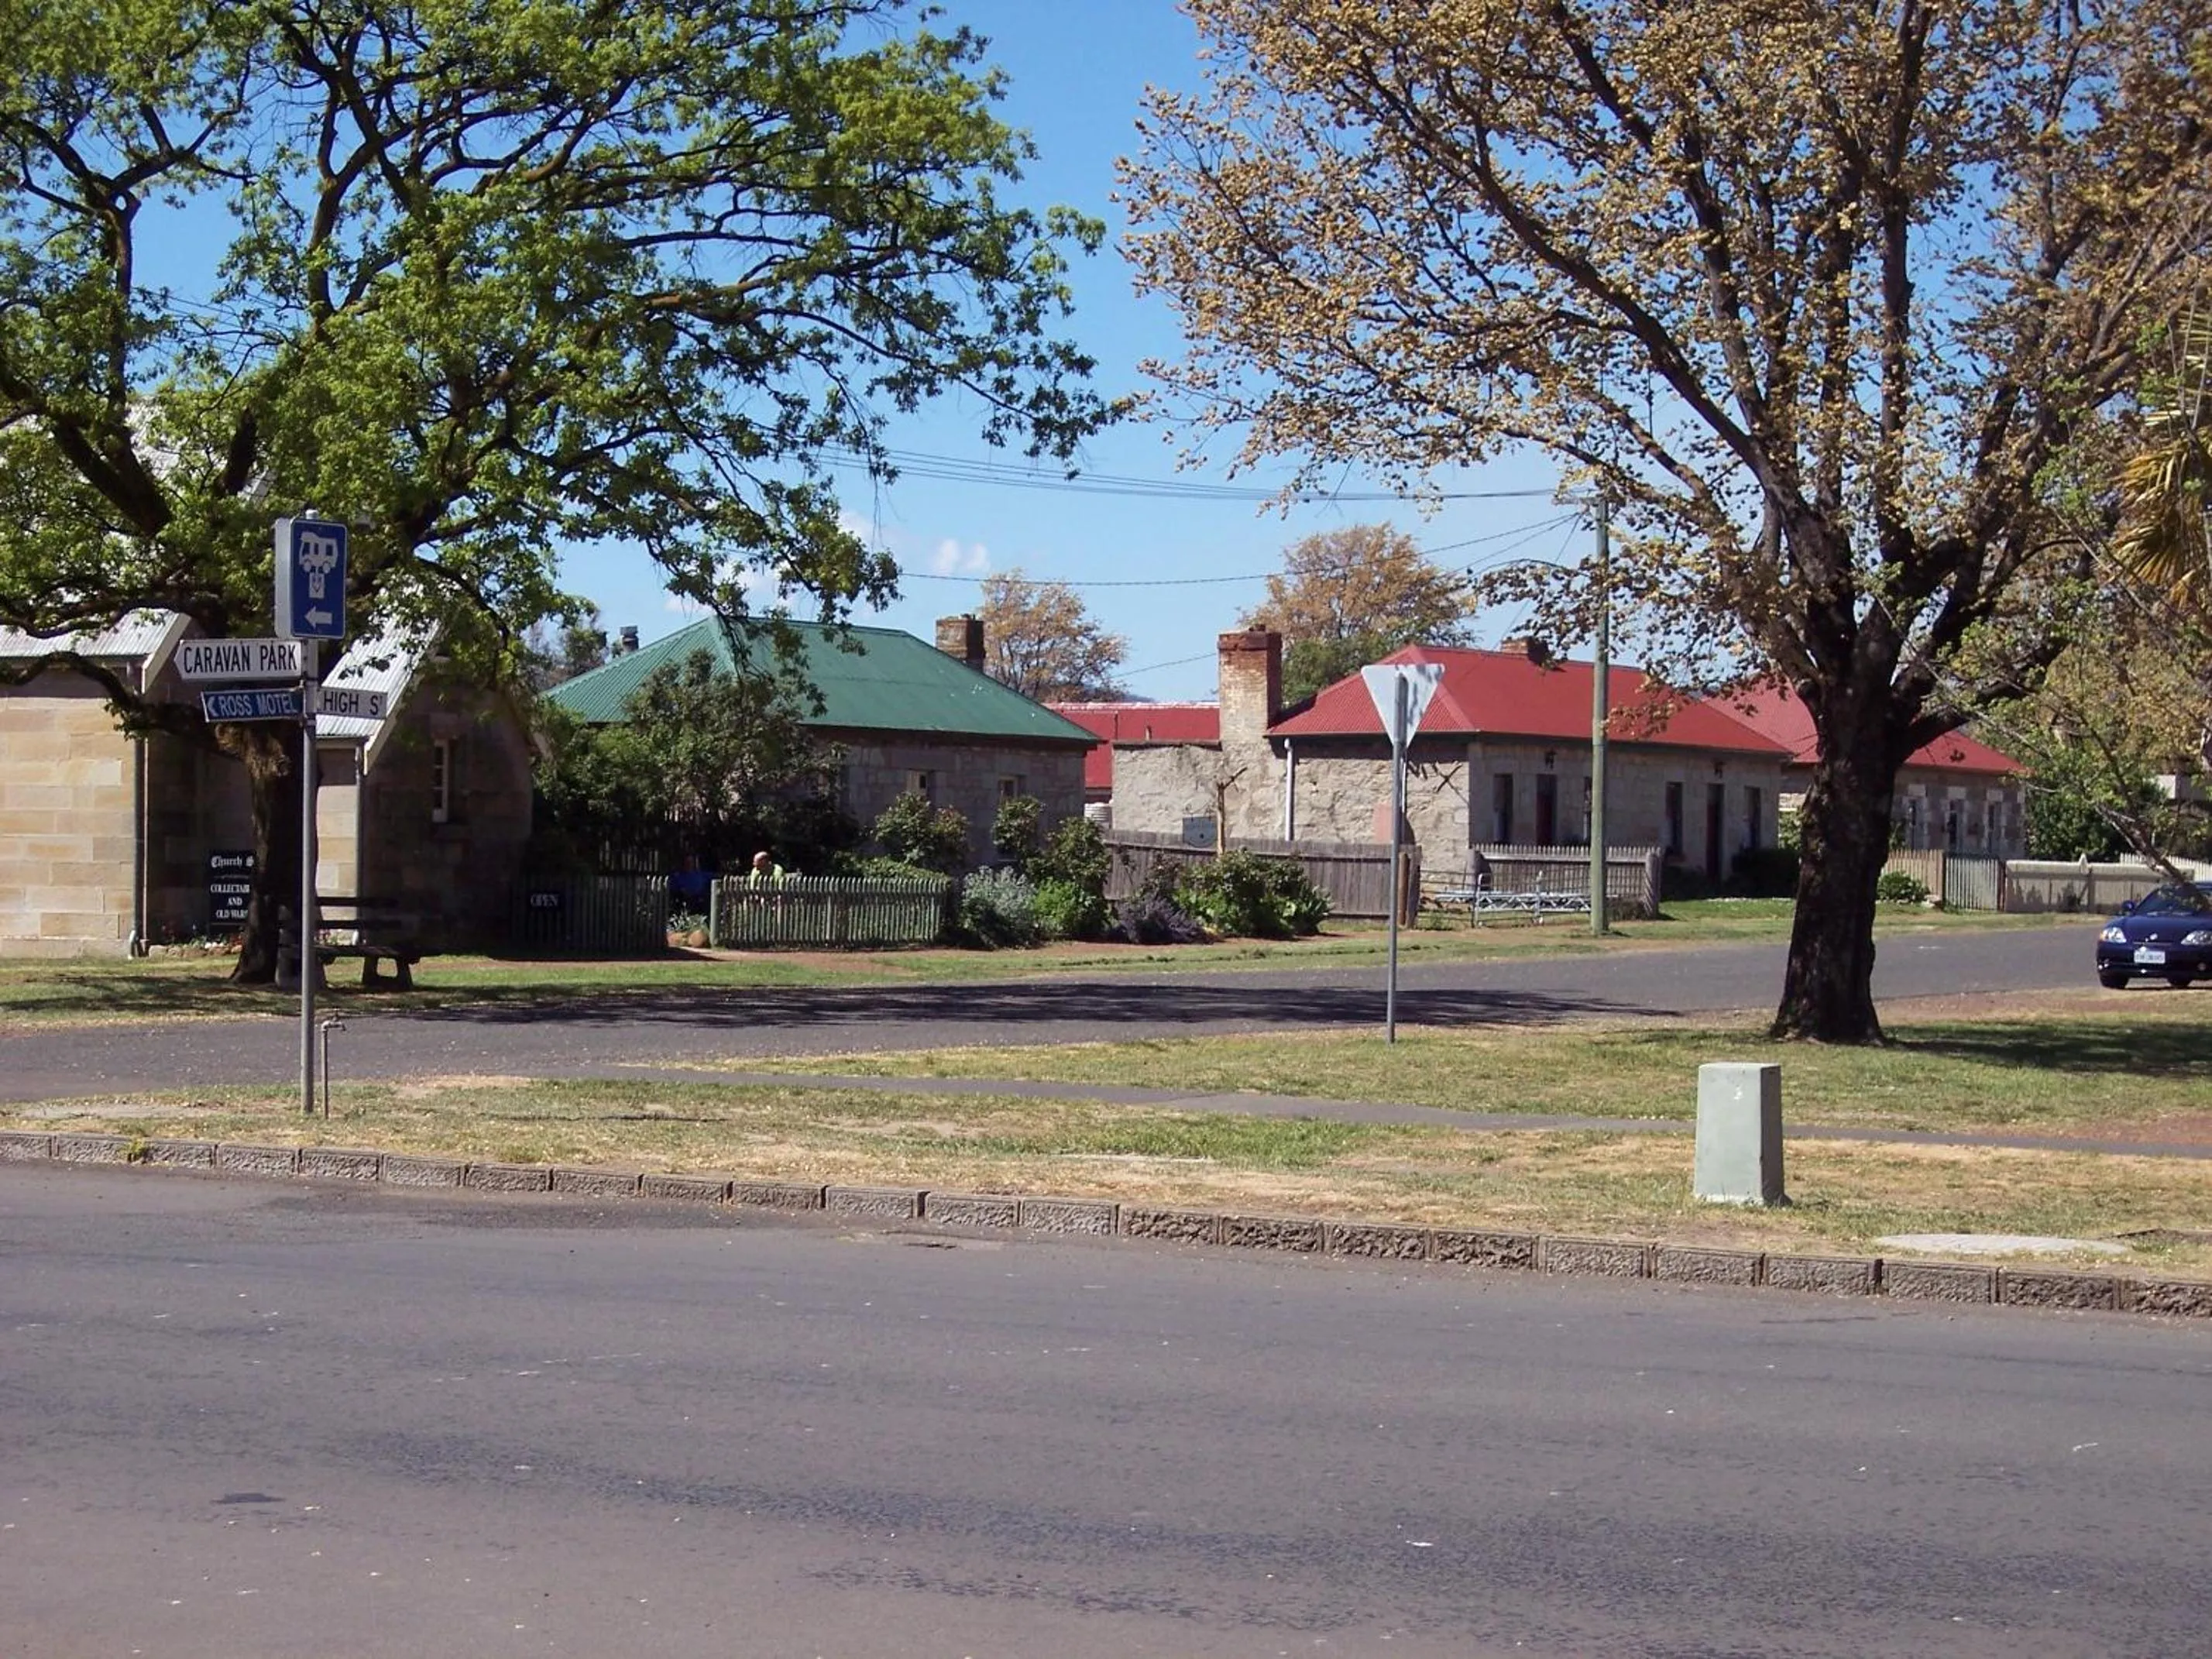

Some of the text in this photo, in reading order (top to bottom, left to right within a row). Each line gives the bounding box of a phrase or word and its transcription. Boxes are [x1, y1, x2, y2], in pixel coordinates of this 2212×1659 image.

[184, 644, 297, 673] CARAVAN PARK
[218, 693, 299, 716] ROSS MOTEL
[324, 690, 359, 713] HIGH
[228, 897, 242, 905] AND
[216, 909, 230, 919] OLD
